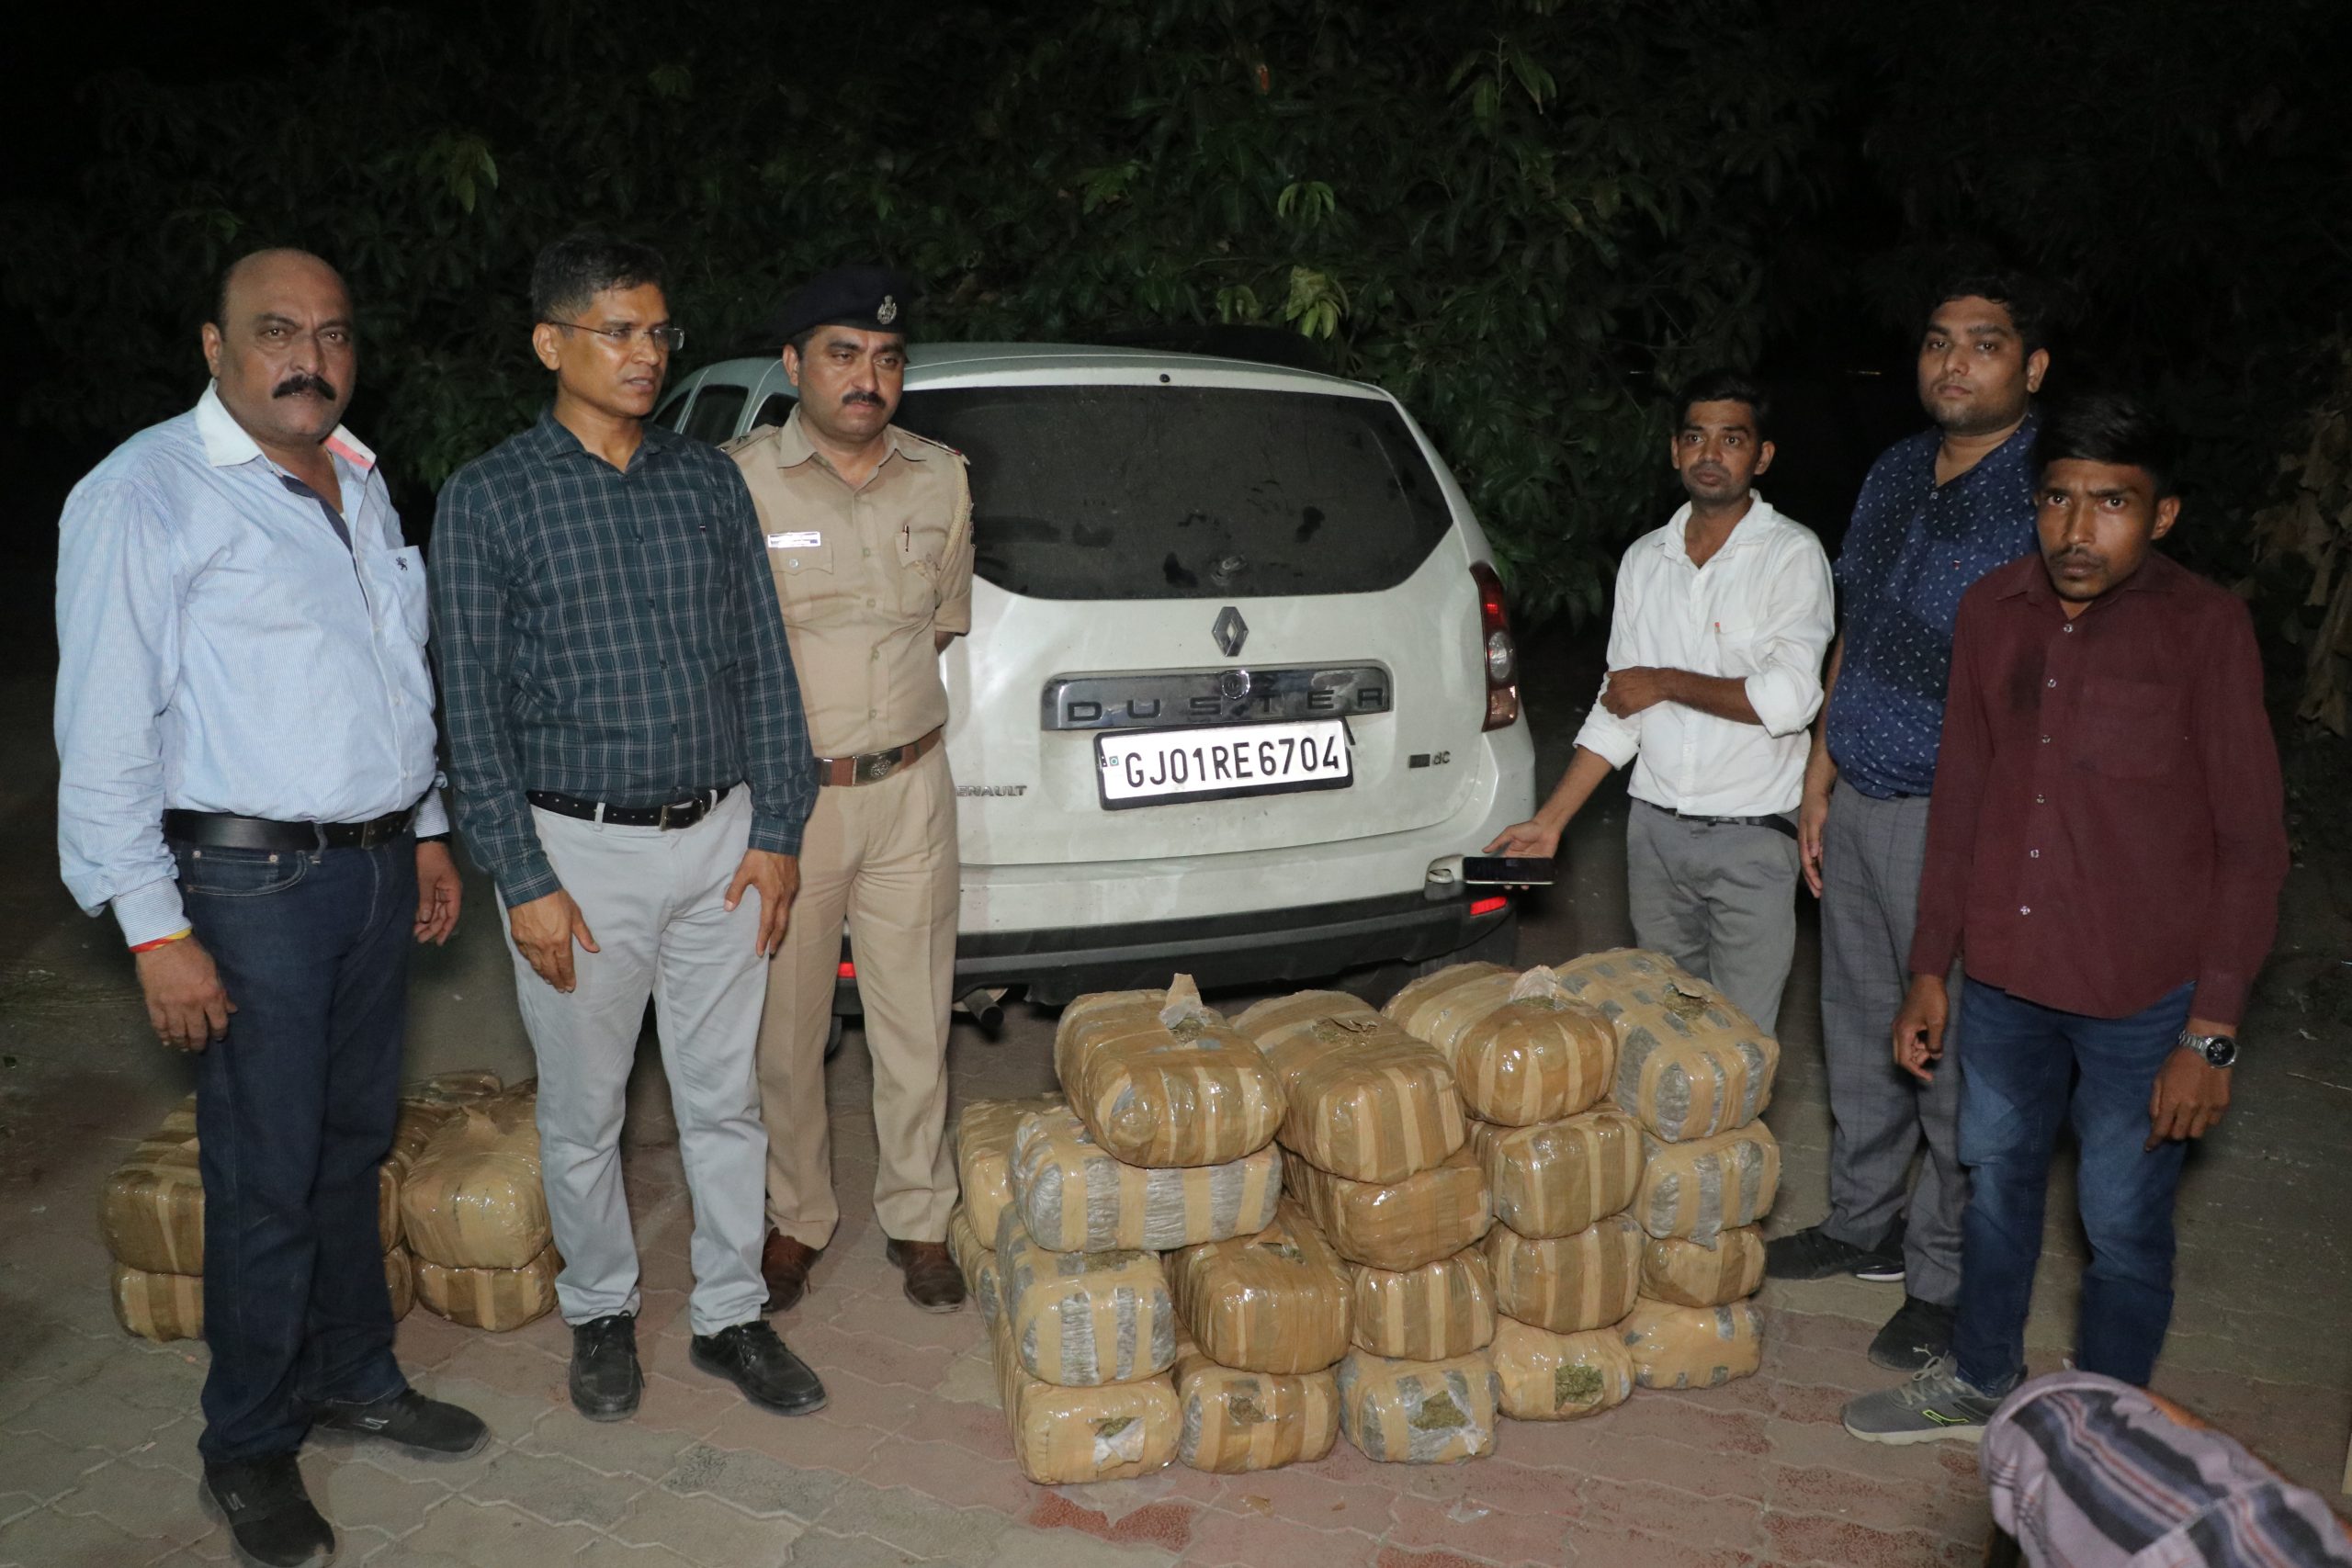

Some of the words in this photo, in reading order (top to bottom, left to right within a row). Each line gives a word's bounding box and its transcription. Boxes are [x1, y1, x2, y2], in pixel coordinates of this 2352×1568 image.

[1067, 687, 1383, 722] DUSTER
[1125, 736, 1340, 789] GJ01RE6704
[956, 785, 1028, 797] ENAULT
